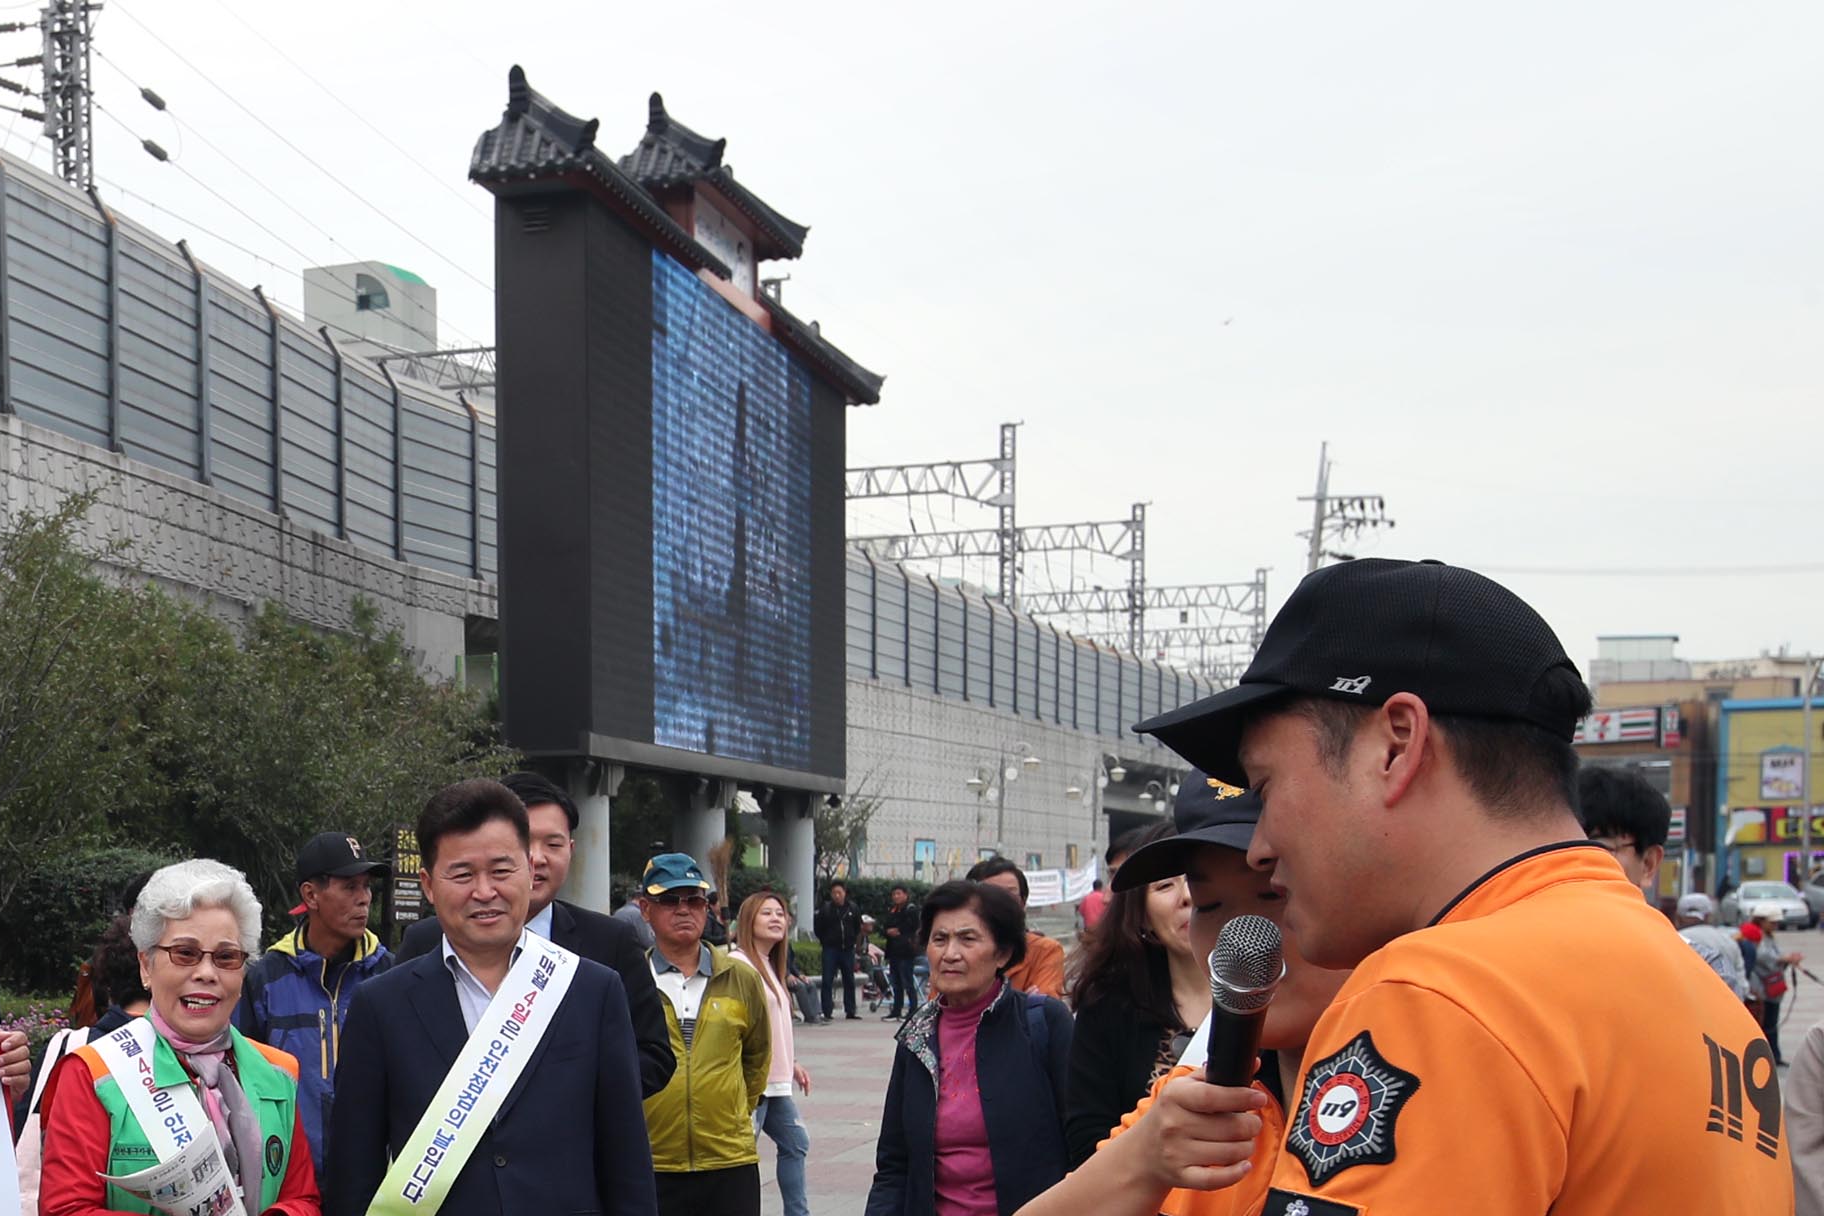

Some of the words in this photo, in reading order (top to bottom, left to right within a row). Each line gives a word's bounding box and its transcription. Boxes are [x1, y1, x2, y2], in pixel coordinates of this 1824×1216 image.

[531, 954, 556, 992] 매월
[499, 989, 538, 1042] 4일은
[111, 1028, 144, 1058] 매월
[445, 1039, 510, 1130] 안전점검의
[1320, 1099, 1358, 1118] 119
[1702, 1032, 1781, 1160] 119
[402, 1127, 456, 1204] 날입니다
